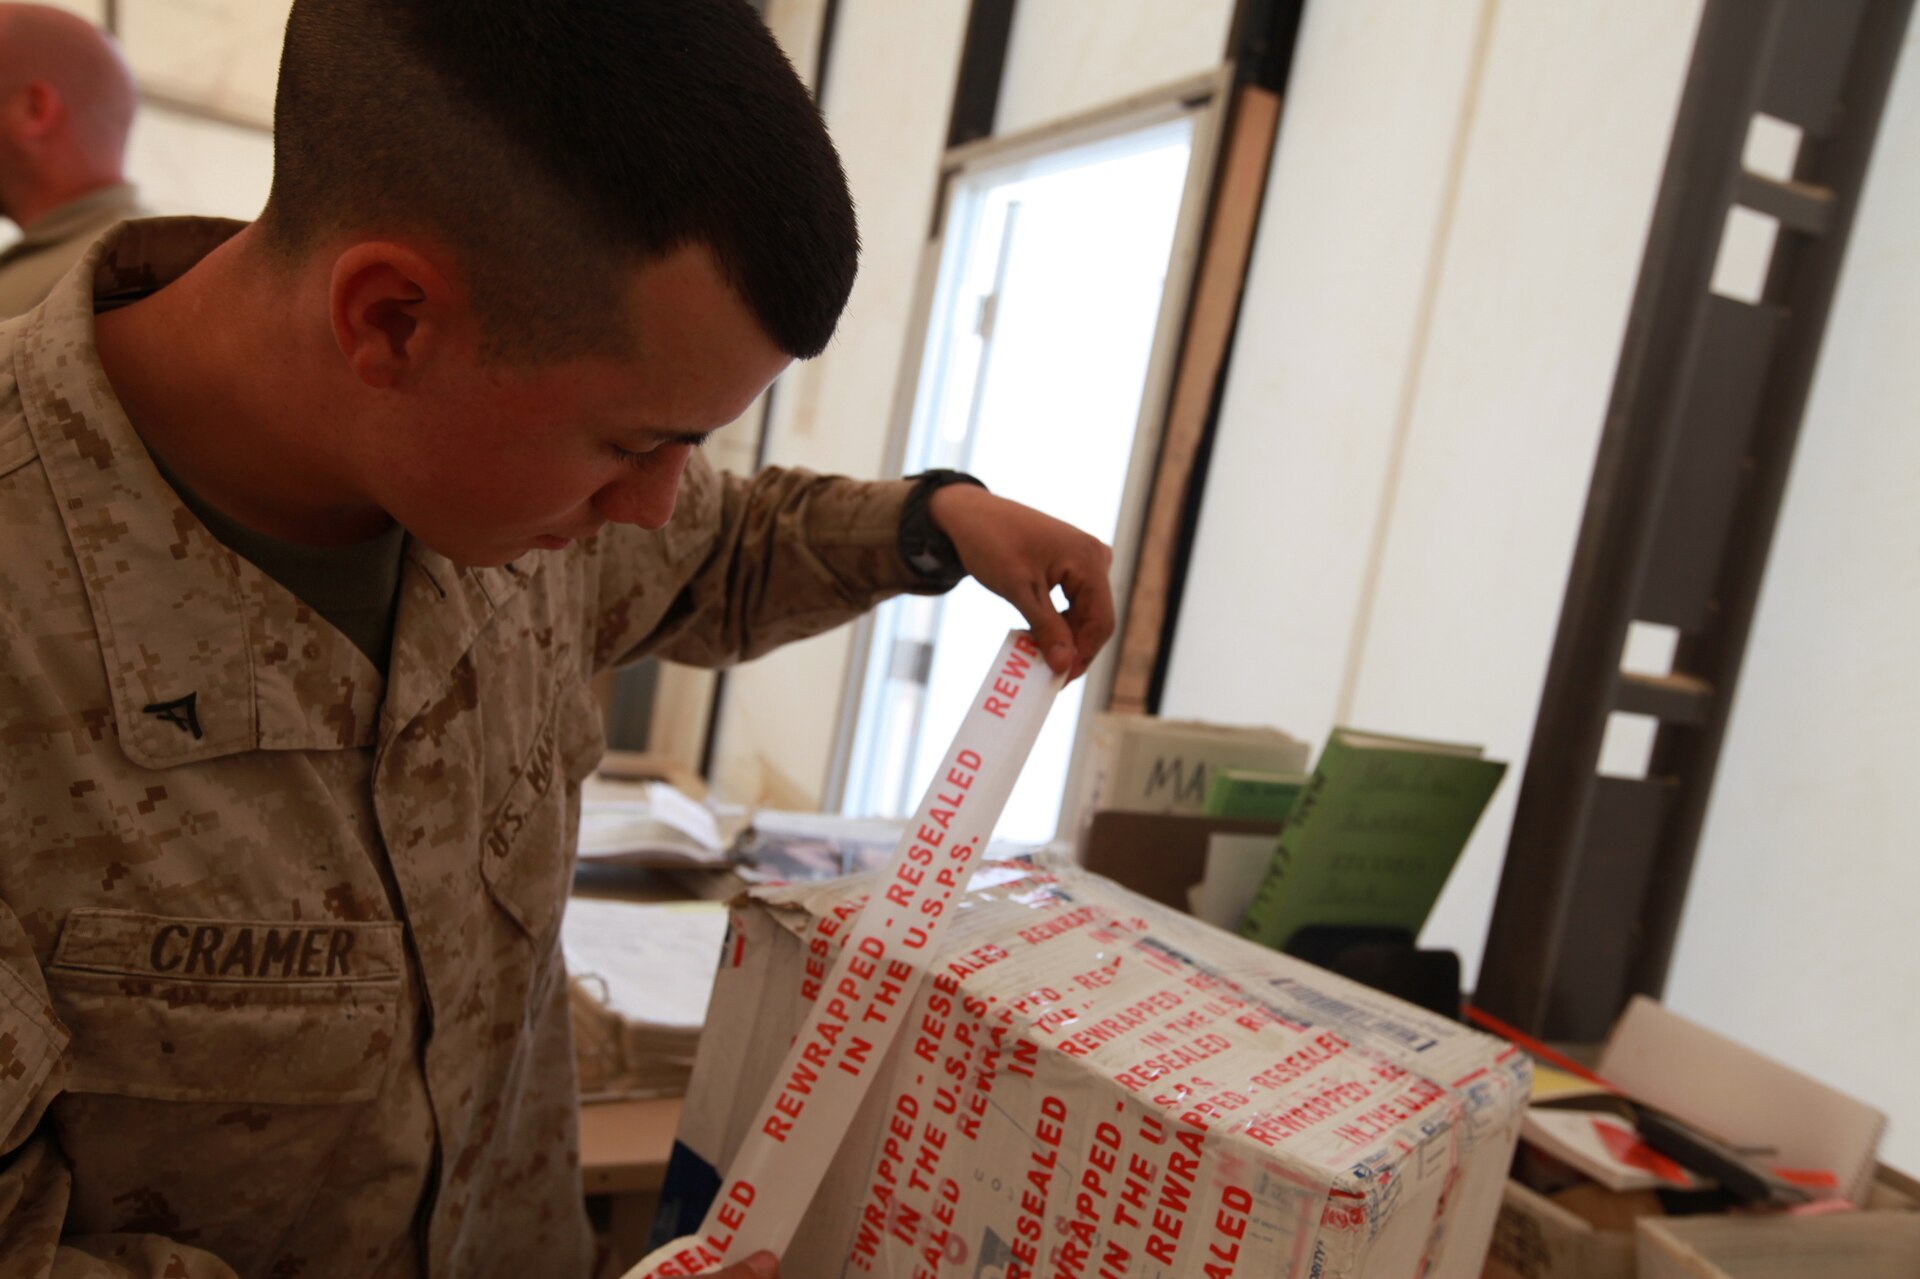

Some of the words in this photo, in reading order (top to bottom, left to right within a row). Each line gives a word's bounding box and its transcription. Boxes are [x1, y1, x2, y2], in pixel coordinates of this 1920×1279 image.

[150, 924, 356, 978] CRAMER
[762, 936, 885, 1144] REWRAPPED
[885, 747, 983, 908] RESEALED
[837, 1036, 873, 1077] IN
[862, 960, 912, 1023] THE
[902, 835, 979, 949] U.S.P.S.
[912, 943, 1009, 1063] RESEALED
[1057, 989, 1184, 1059] REWRAPPED
[1007, 1038, 1041, 1079] IN
[1113, 1033, 1232, 1093] RESEALED
[893, 1203, 922, 1247] IN
[908, 1122, 948, 1193] THE
[933, 995, 998, 1116] U.S.P.S.
[1245, 1081, 1372, 1147] REWRAPPED
[1005, 1095, 1067, 1279] RESEALED
[1113, 1153, 1159, 1231] THE
[1145, 1091, 1250, 1267] REWRAPPED
